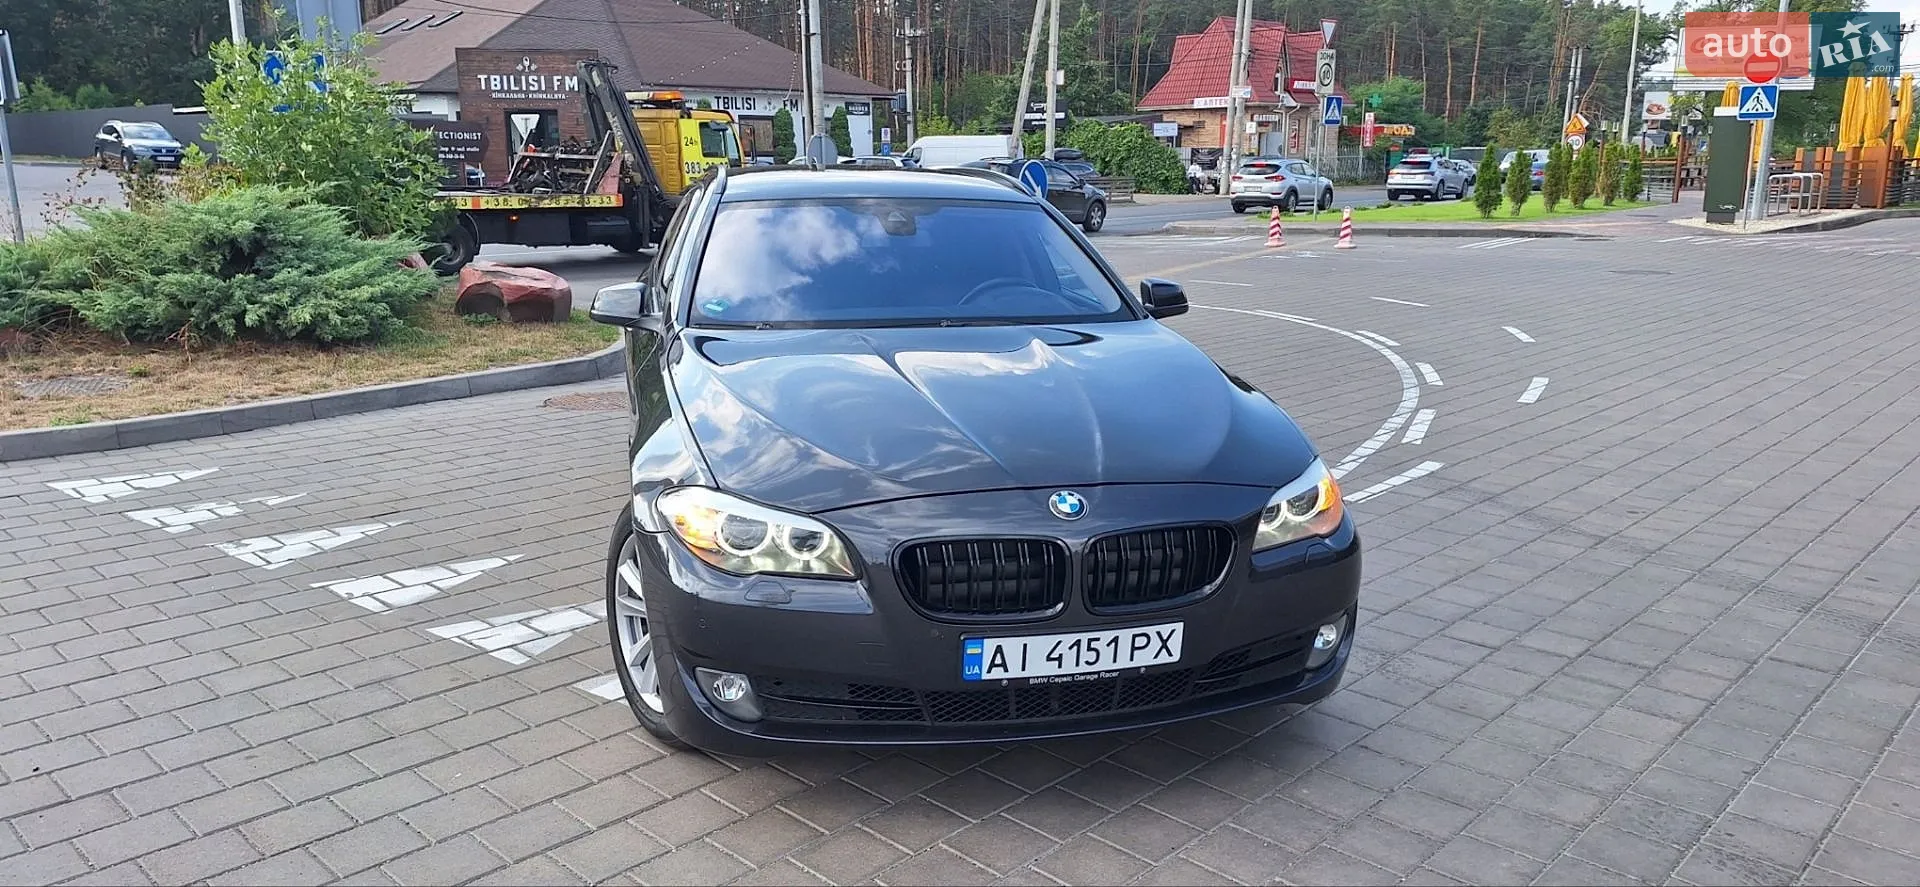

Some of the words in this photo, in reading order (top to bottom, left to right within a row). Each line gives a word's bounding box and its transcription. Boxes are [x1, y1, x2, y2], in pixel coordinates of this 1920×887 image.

[1322, 69, 1331, 80] 10
[477, 74, 546, 91] TBILISI
[553, 75, 579, 91] FM
[714, 96, 756, 111] TBILISI
[782, 98, 799, 112] FM
[1205, 97, 1230, 108] АПТЕК
[986, 643, 1028, 674] AI
[1046, 635, 1119, 669] 4151
[1129, 629, 1176, 662] PX
[965, 666, 981, 675] UA
[1029, 677, 1048, 685] BMW
[1073, 674, 1098, 682] Garage
[1099, 671, 1120, 679] Racer
